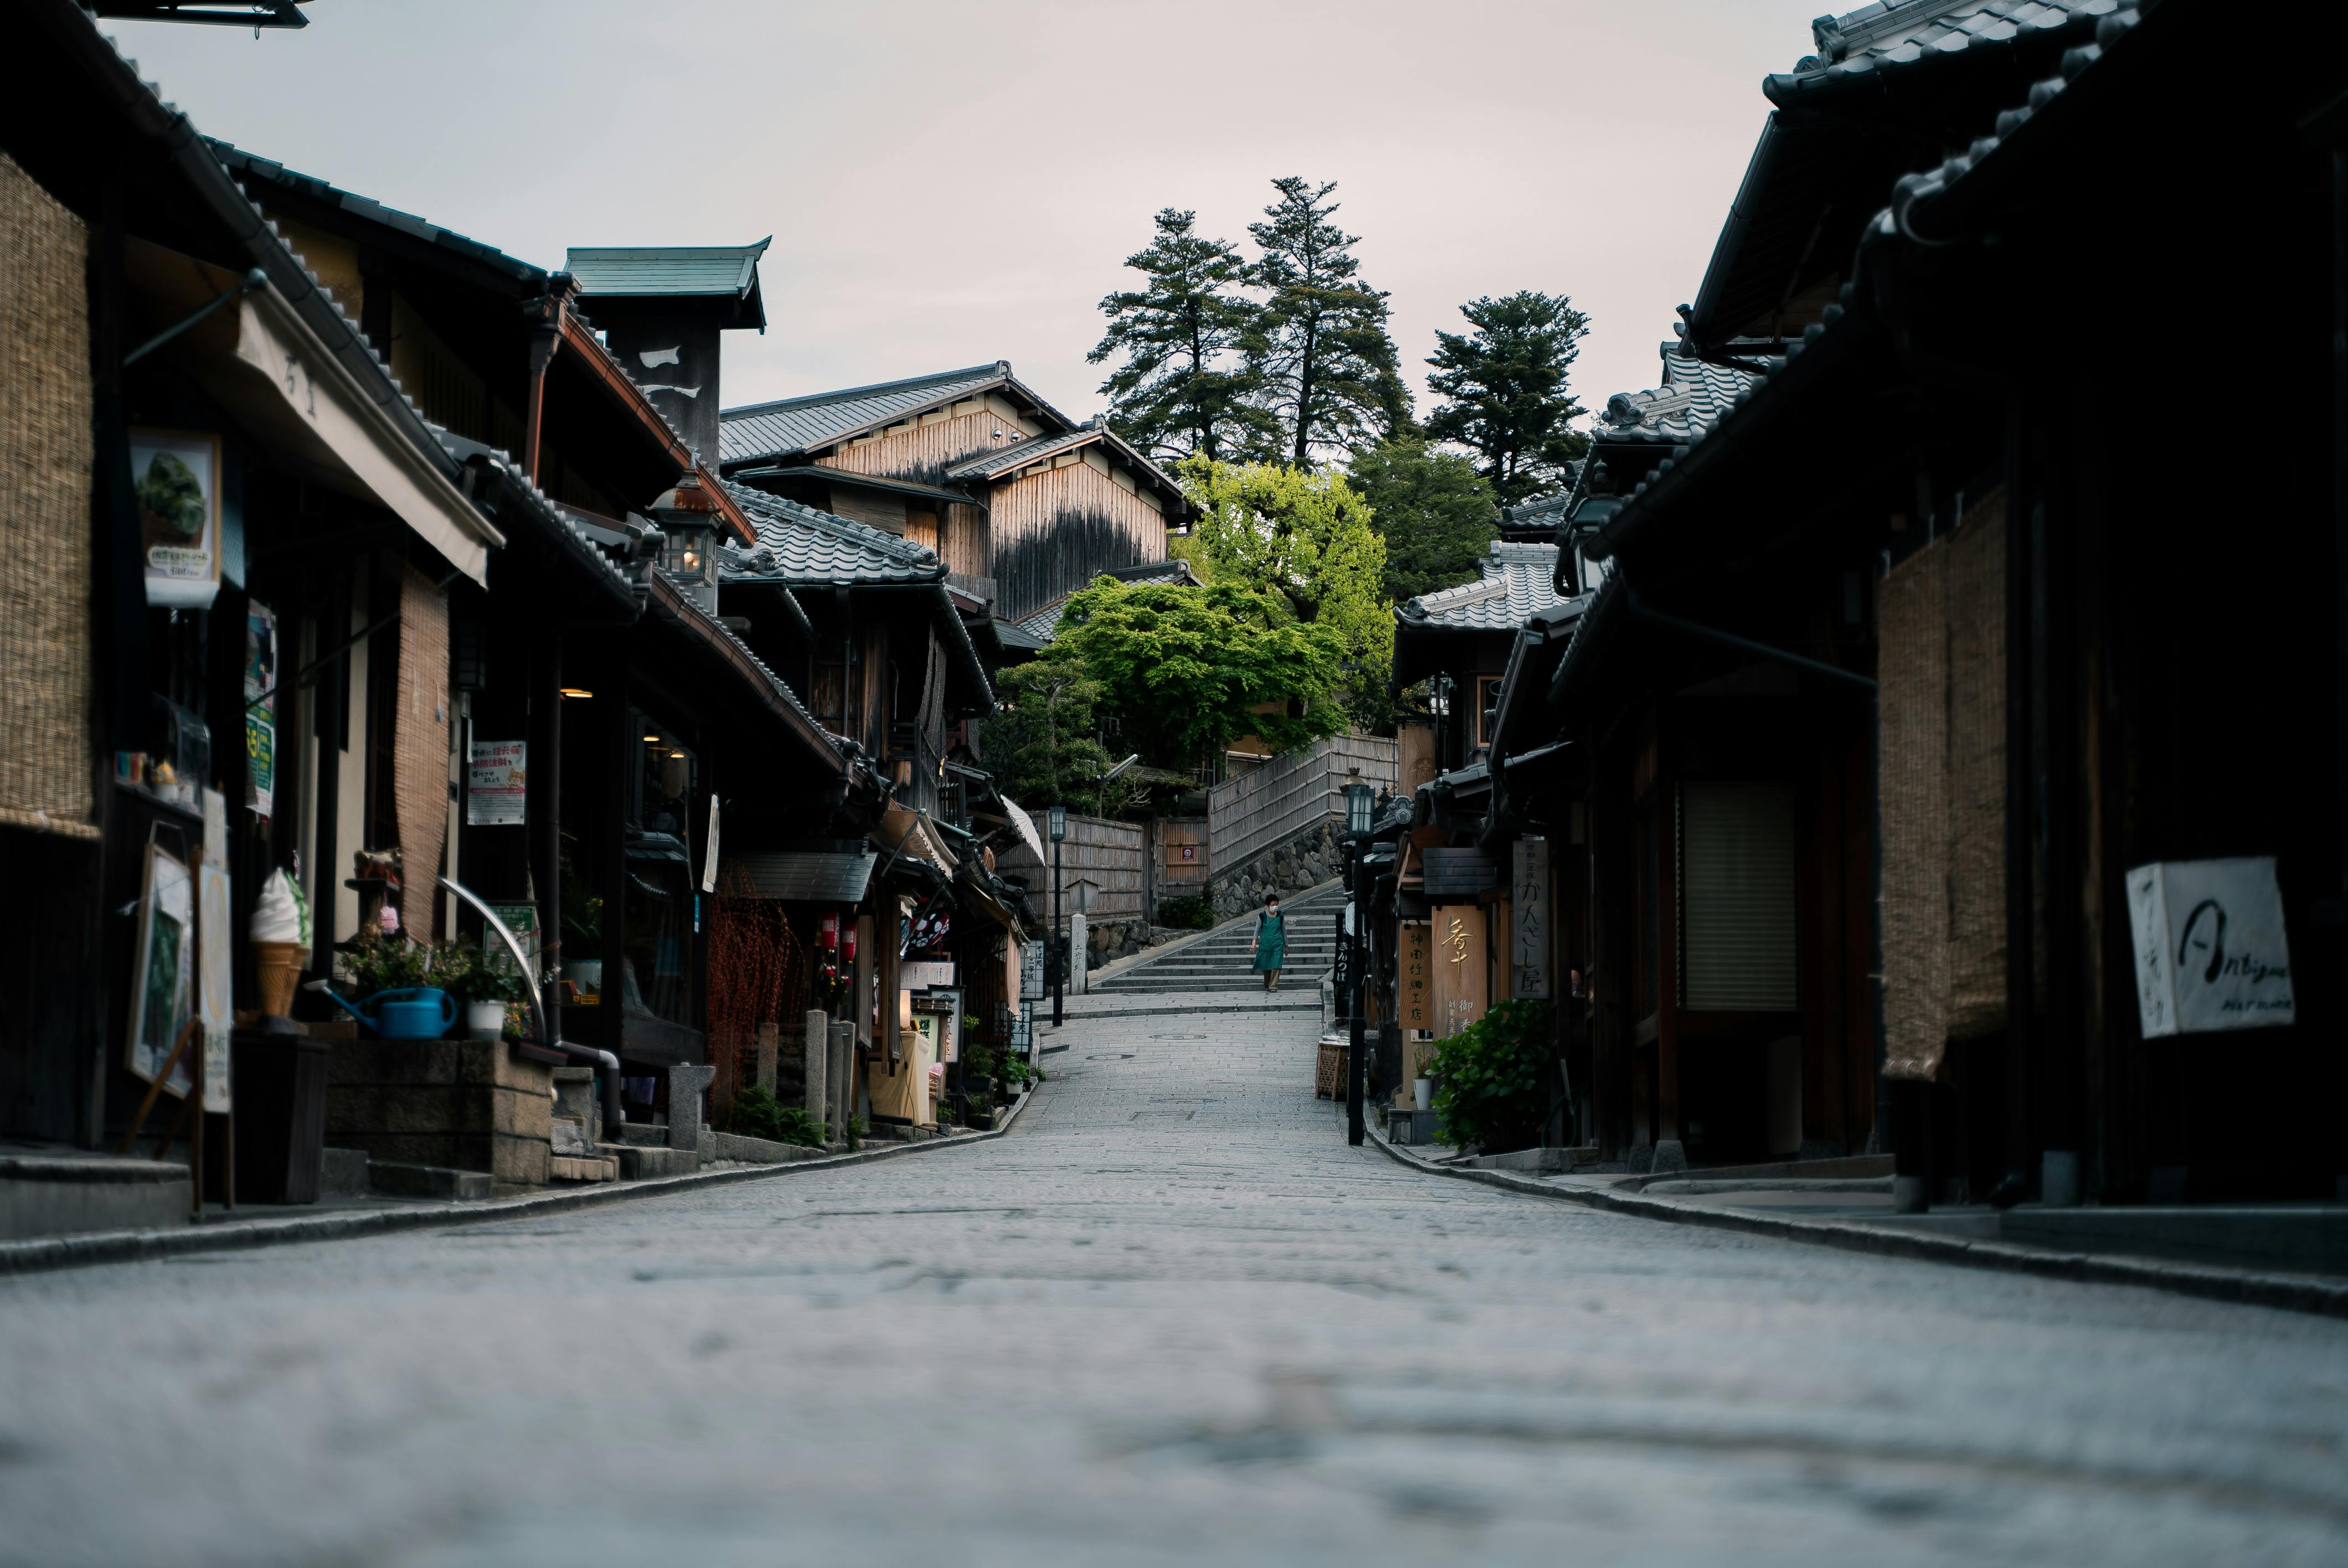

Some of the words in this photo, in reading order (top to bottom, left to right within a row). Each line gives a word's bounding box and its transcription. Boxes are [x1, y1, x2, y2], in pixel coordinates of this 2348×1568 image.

[1337, 941, 1348, 982] きんつば
[1409, 933, 1423, 1021] 神田竹細工店
[1441, 919, 1476, 992] 香十
[1521, 882, 1542, 992] かんざし屋
